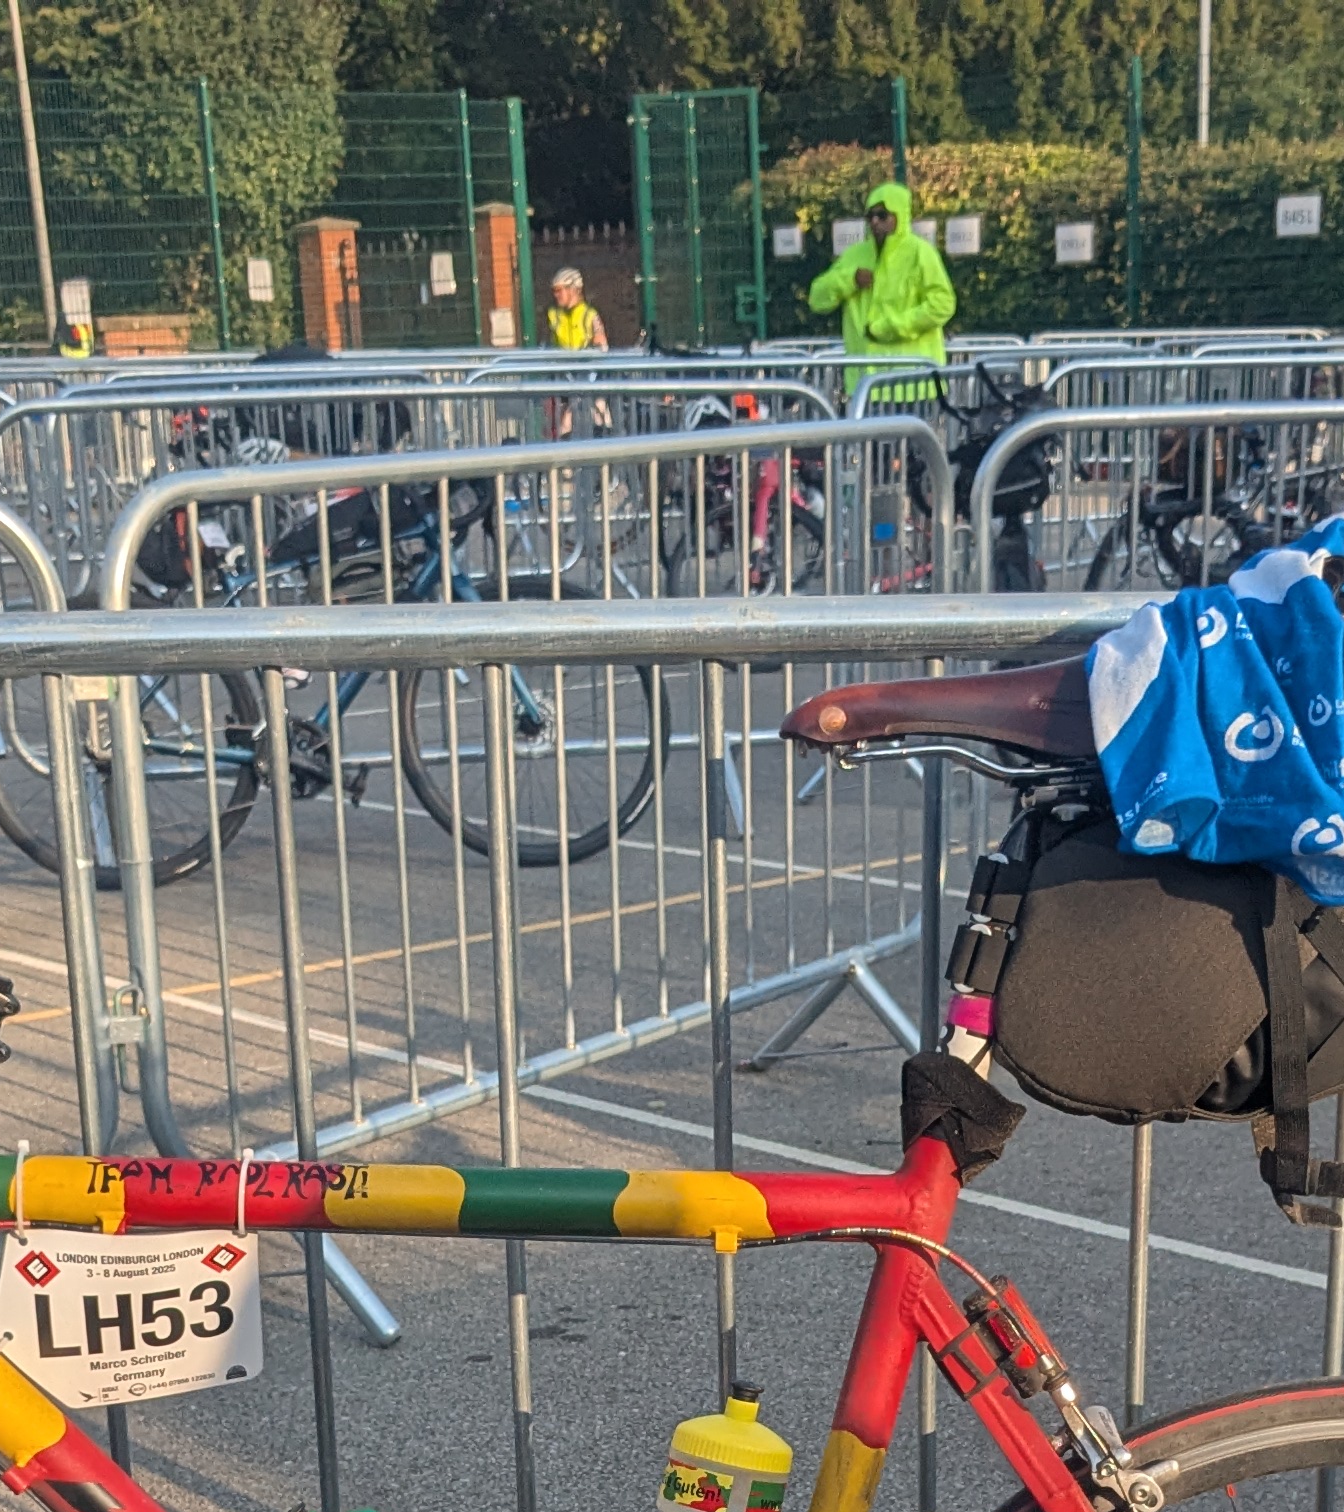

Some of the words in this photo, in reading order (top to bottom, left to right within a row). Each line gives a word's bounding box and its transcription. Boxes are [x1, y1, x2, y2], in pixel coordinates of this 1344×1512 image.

[56, 1252, 99, 1264] LONDON
[101, 1253, 160, 1265] EDINBURGH
[163, 1247, 205, 1263] LONDON
[86, 1269, 94, 1278] 3
[103, 1268, 111, 1278] 8
[113, 1266, 149, 1280] August
[151, 1264, 176, 1276] 2025
[34, 1280, 234, 1359] LH53
[89, 1359, 128, 1371] Marco
[130, 1349, 187, 1367] Schreiber
[113, 1366, 166, 1384] Germany
[674, 1477, 722, 1503] Guten!
